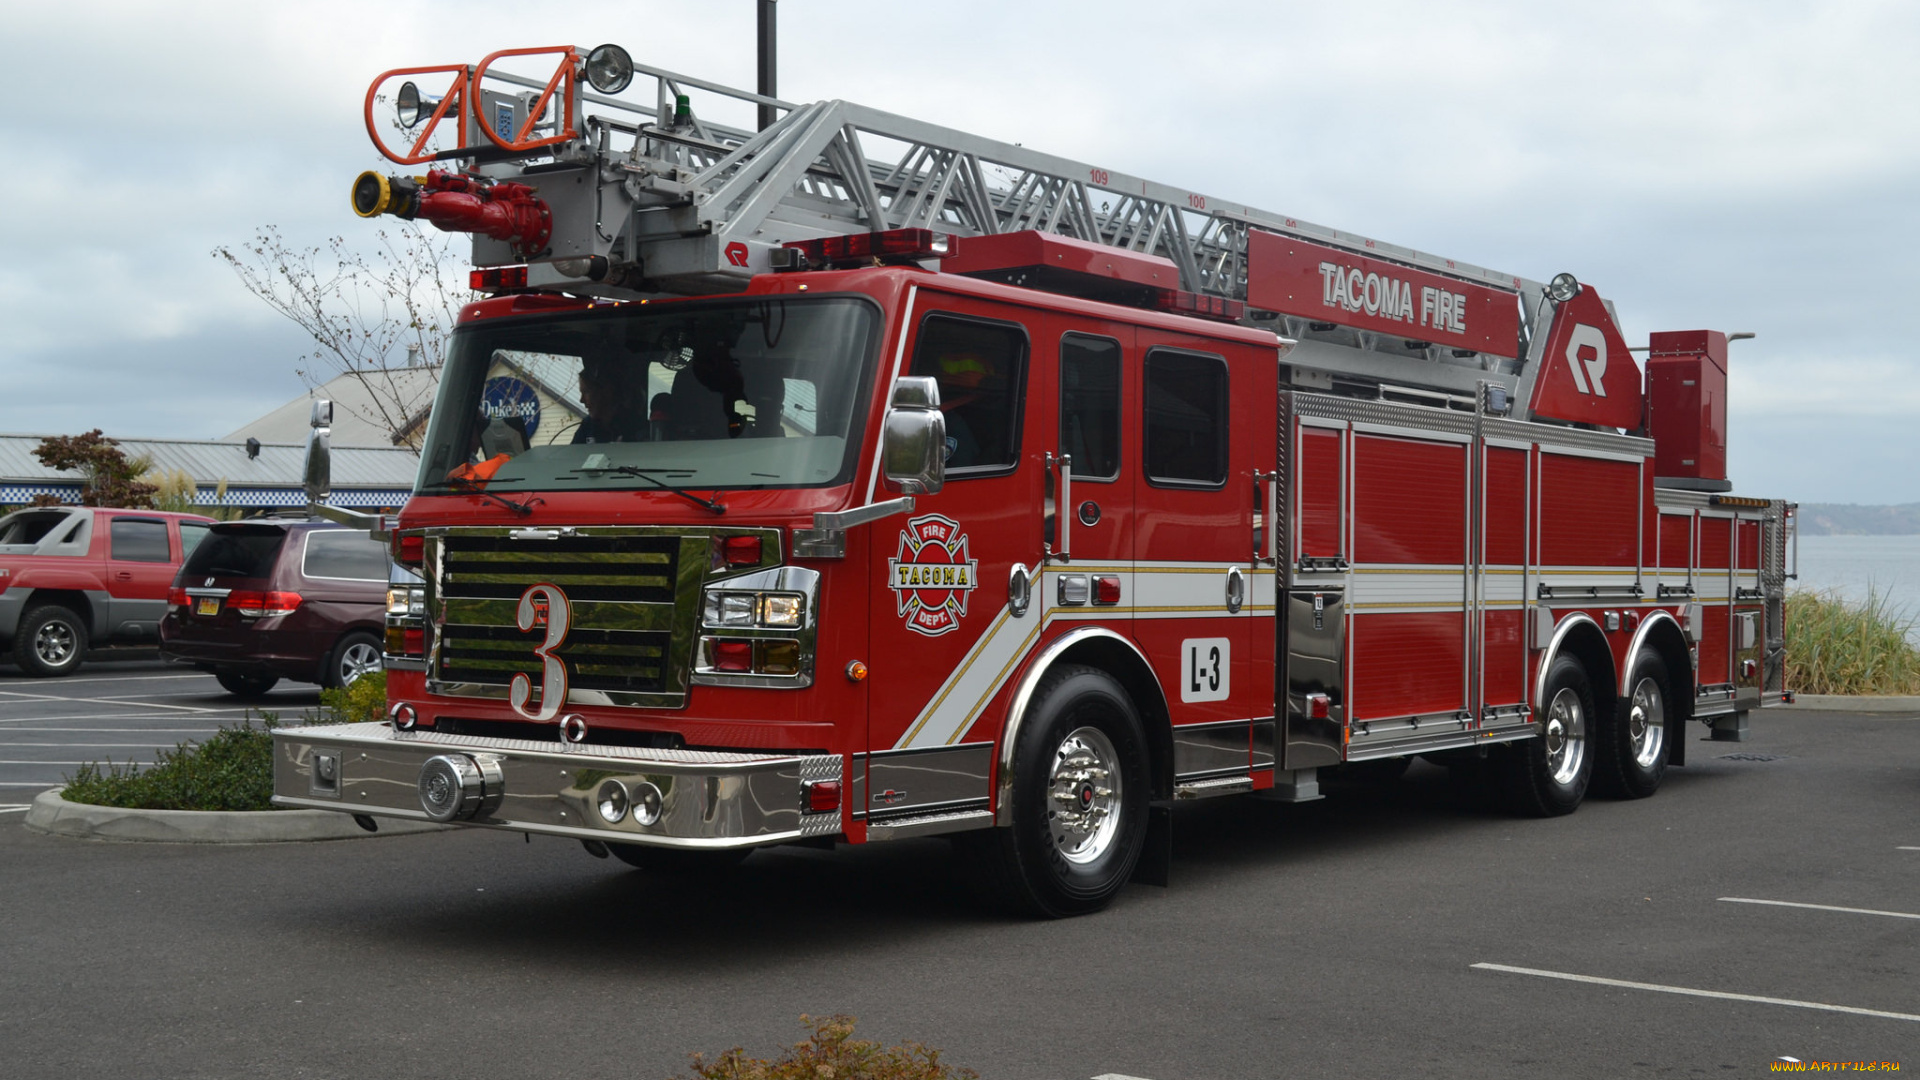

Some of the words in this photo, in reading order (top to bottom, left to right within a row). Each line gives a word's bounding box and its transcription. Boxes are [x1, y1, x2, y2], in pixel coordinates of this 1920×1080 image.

[1090, 168, 1108, 185] 109
[1188, 193, 1205, 209] 100
[1318, 261, 1415, 324] TACOMA
[1420, 285, 1467, 335] FIRE
[922, 525, 947, 539] FIRE
[898, 566, 968, 585] TACOMA
[919, 611, 947, 626] DEPT.
[509, 582, 571, 722] 3
[1191, 646, 1220, 692] L-3
